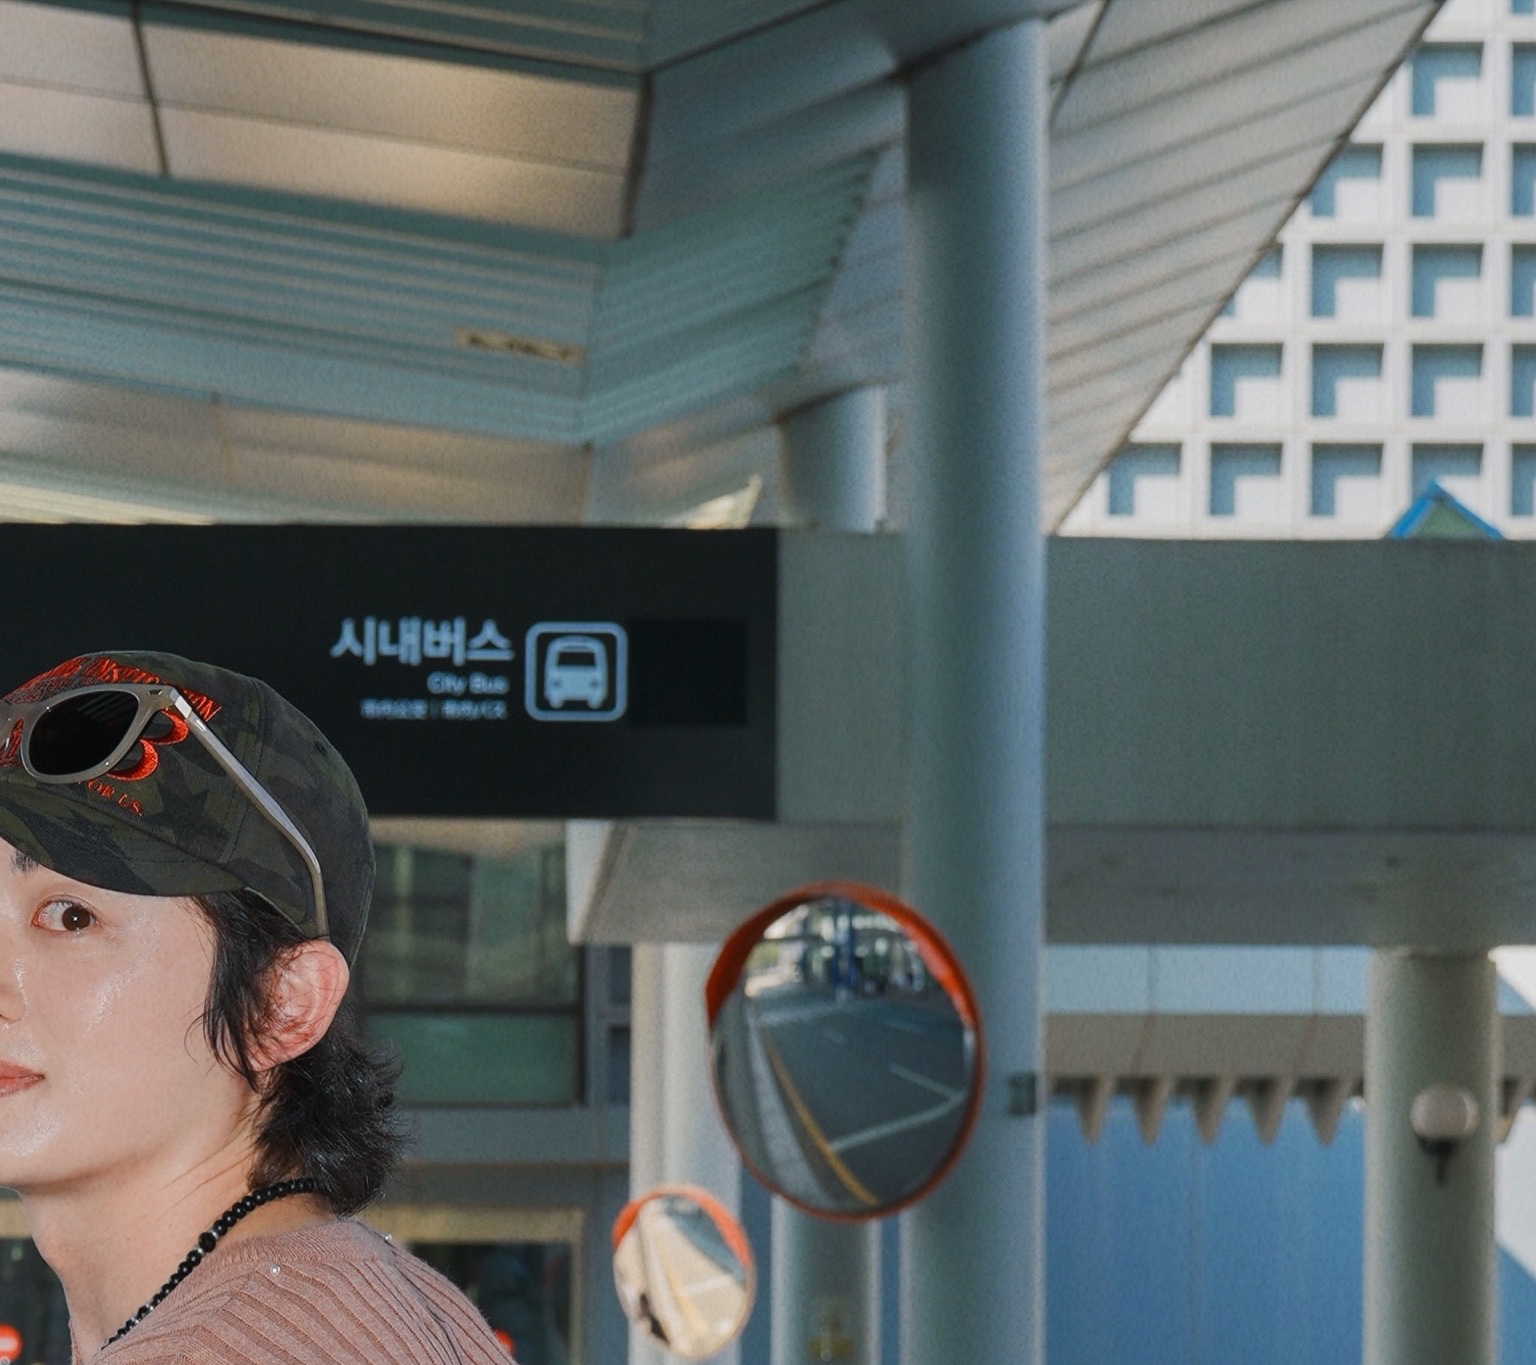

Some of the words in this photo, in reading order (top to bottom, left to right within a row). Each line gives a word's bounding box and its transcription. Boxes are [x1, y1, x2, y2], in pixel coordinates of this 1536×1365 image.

[330, 616, 515, 666] 시내버스
[427, 671, 468, 696] City
[469, 672, 510, 695] Bus
